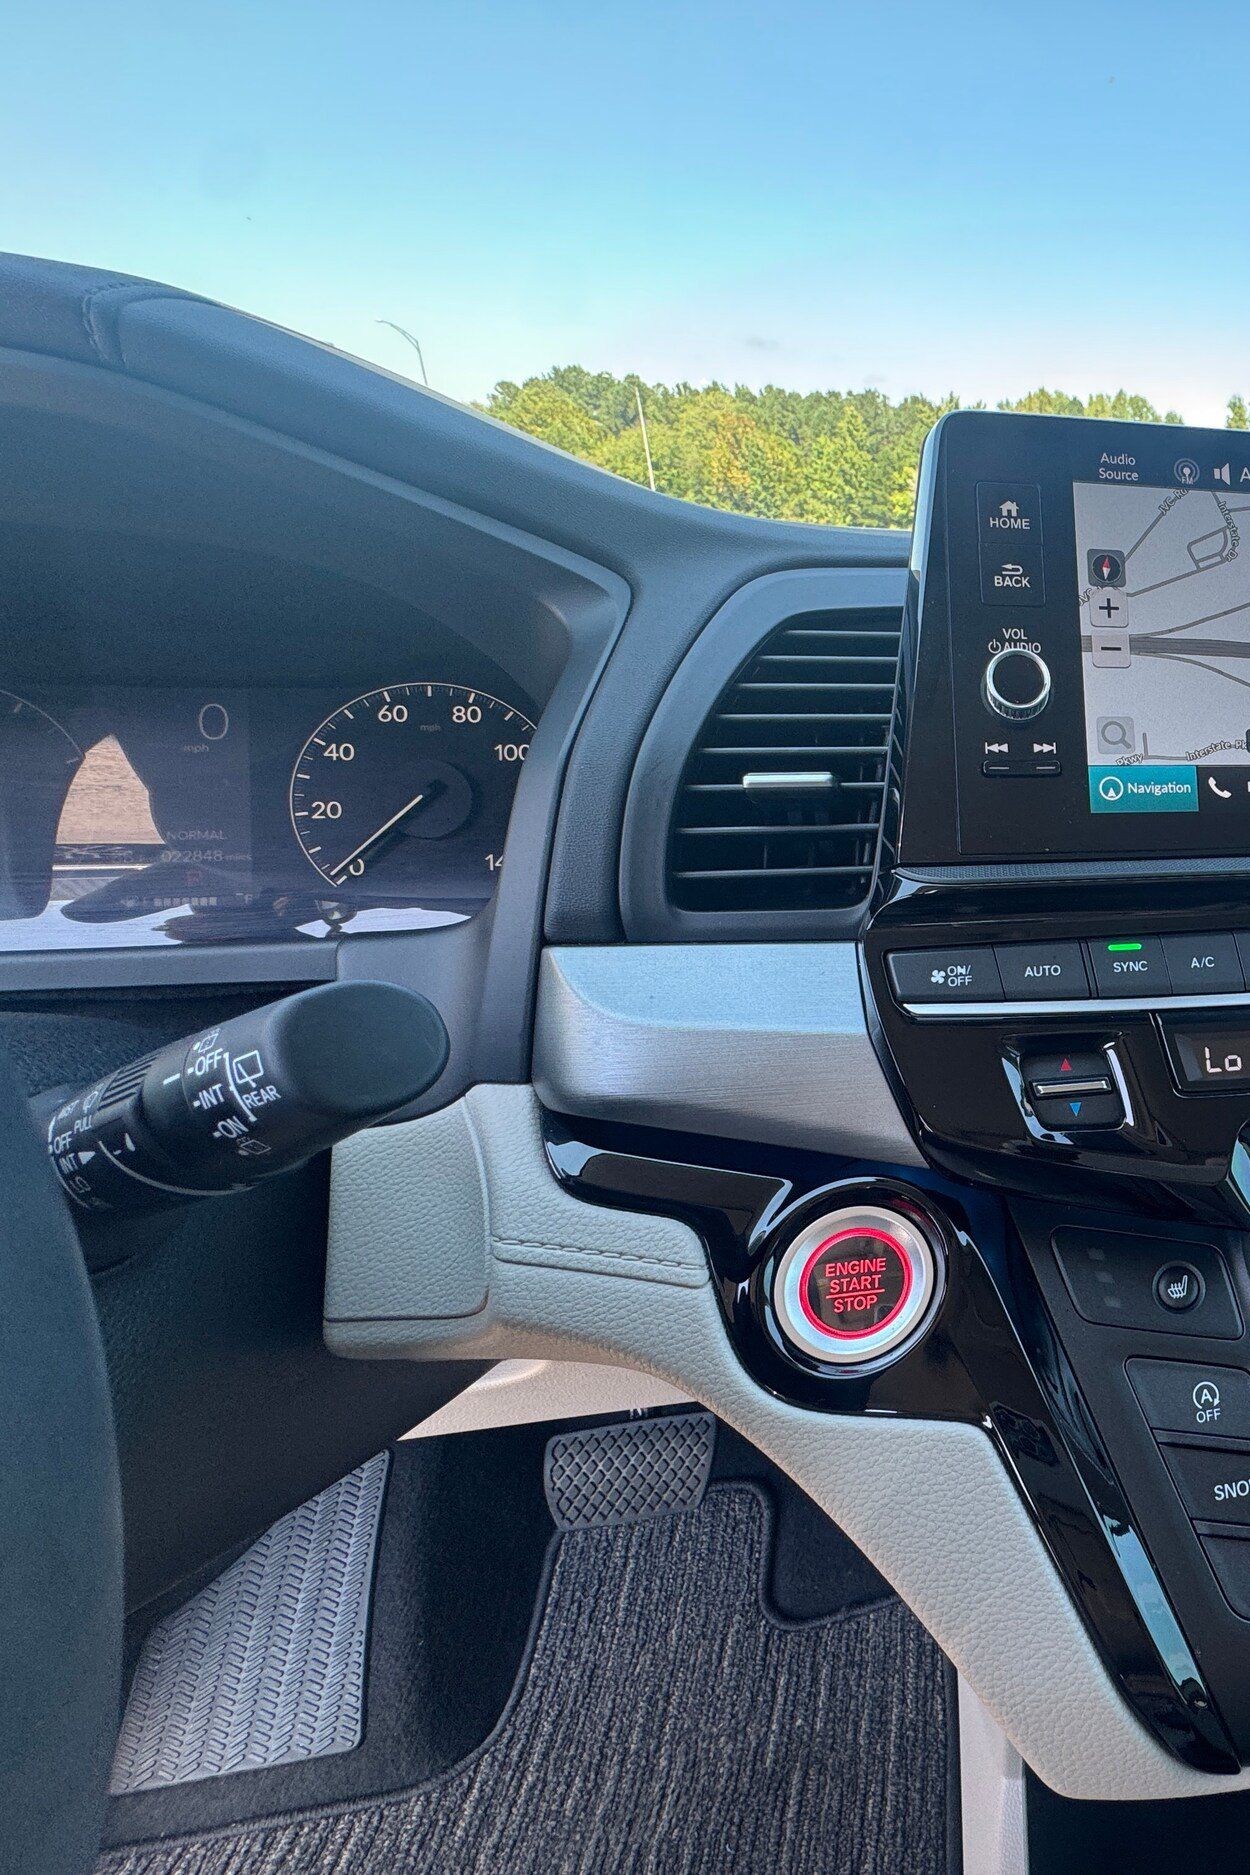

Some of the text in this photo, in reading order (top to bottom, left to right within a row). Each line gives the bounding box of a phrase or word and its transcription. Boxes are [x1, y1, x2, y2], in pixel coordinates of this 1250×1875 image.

[1100, 453, 1136, 466] Audio
[1098, 468, 1139, 481] Source
[1157, 496, 1177, 516] JVC
[990, 517, 1031, 530] HOME
[1219, 501, 1241, 549] Interstate
[994, 575, 1031, 588] BACK
[1002, 628, 1028, 639] VOL
[1003, 642, 1041, 654] AUDIO
[199, 703, 229, 740] 0
[378, 705, 408, 723] 60
[452, 706, 482, 723] 80
[420, 724, 441, 732] mph
[184, 743, 209, 753] mph
[324, 743, 354, 761] 40
[494, 744, 530, 761] 100
[1185, 740, 1232, 762] Interstate
[1116, 753, 1143, 766] Pkwy
[1128, 781, 1191, 796] Navigation
[311, 801, 342, 819] 20
[166, 830, 225, 840] NORMAL
[350, 858, 365, 876] 0
[485, 854, 504, 871] 14
[947, 964, 971, 976] ON/
[1024, 964, 1061, 978] AUTO
[1113, 960, 1148, 973] SYNC
[1190, 956, 1215, 969] A/C
[948, 975, 973, 987] OFF
[195, 1048, 223, 1075] OFF
[199, 1083, 225, 1109] INT
[242, 1085, 281, 1108] REAR
[74, 1115, 92, 1134] PULL
[218, 1115, 249, 1138] ON
[54, 1131, 73, 1154] OFF
[59, 1153, 79, 1174] INT
[825, 1256, 887, 1278] ENGINE
[829, 1274, 881, 1292] START
[833, 1295, 878, 1314] STOP
[1196, 1408, 1222, 1424] OFF
